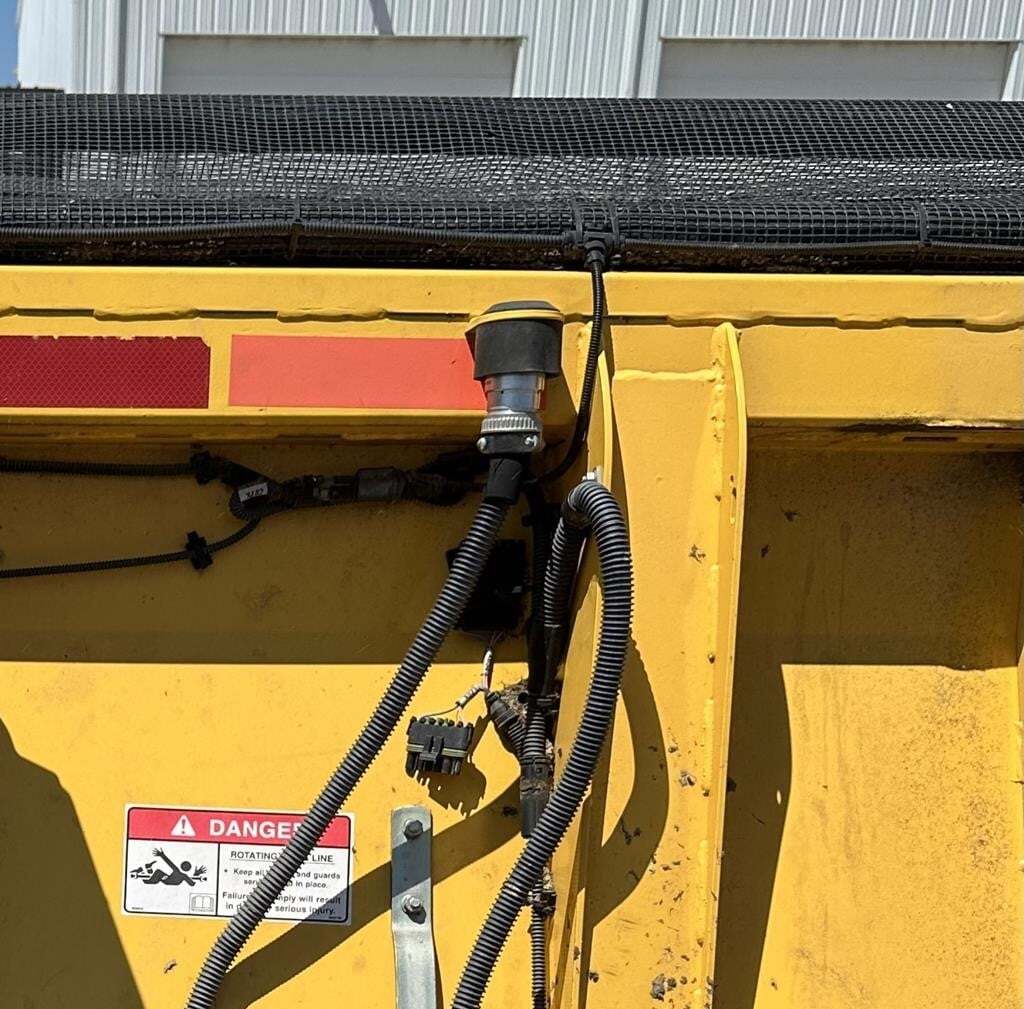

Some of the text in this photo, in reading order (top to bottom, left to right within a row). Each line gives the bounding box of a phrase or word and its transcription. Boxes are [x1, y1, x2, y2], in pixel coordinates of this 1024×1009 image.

[230, 850, 277, 860] ROTATING
[233, 868, 253, 877] Keep
[314, 872, 341, 881] guards
[305, 881, 328, 890] place.
[316, 896, 341, 905] result
[226, 902, 233, 910] in
[275, 904, 307, 913] serious
